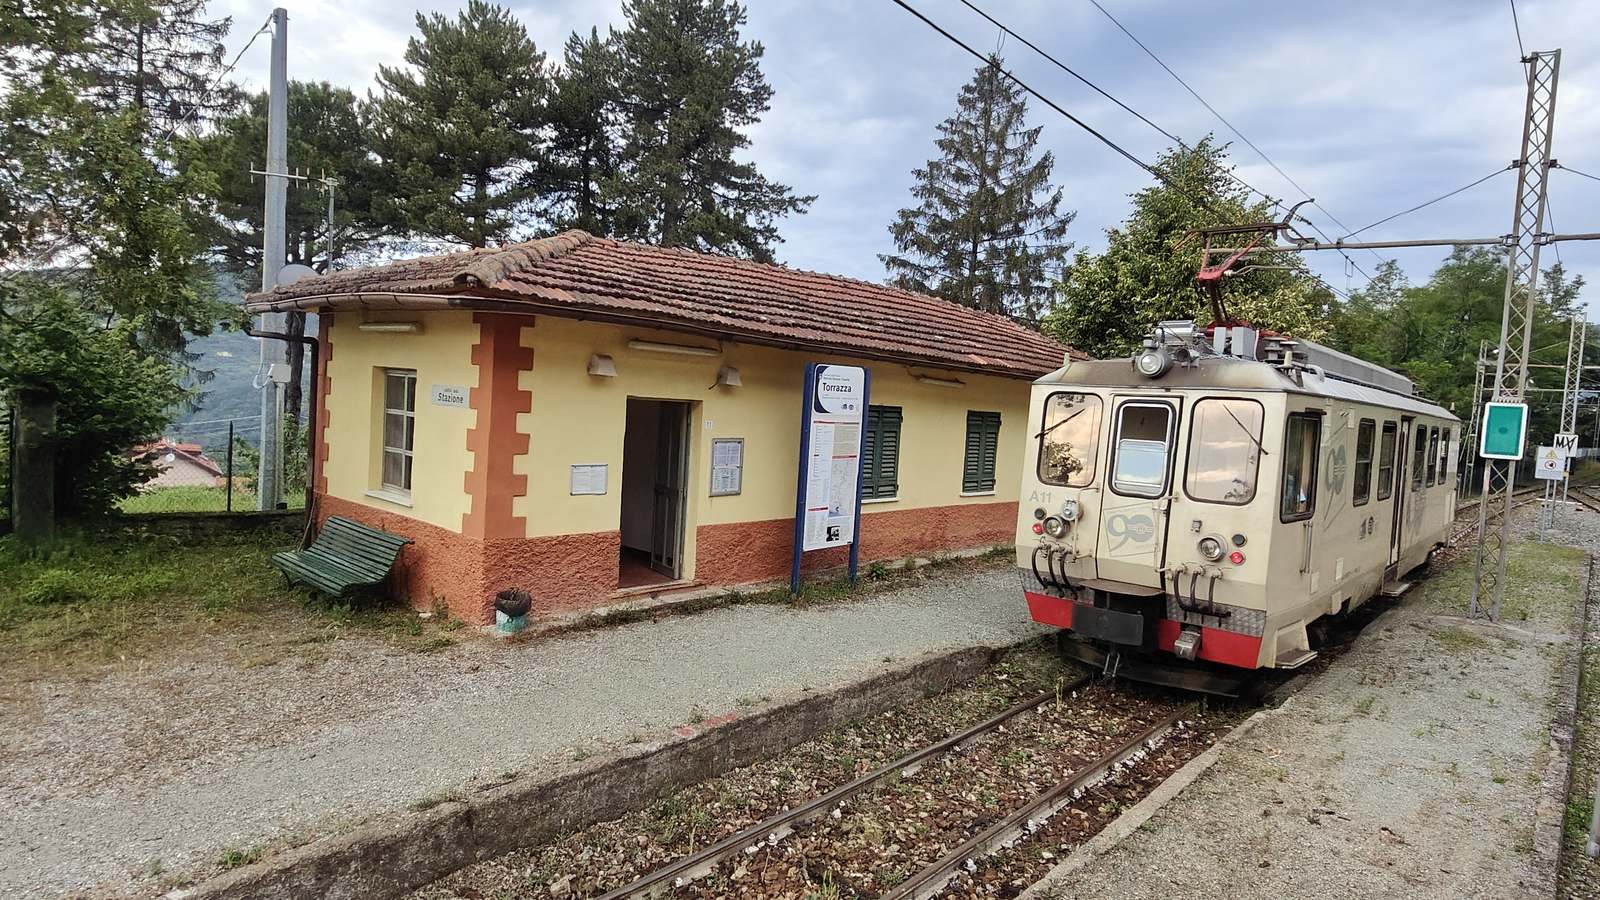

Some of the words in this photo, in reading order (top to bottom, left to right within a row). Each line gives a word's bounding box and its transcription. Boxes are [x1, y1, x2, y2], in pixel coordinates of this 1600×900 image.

[822, 382, 852, 393] Torrazza
[437, 392, 464, 404] Stazione
[1028, 490, 1052, 503] A11
[1107, 513, 1153, 552] 90
